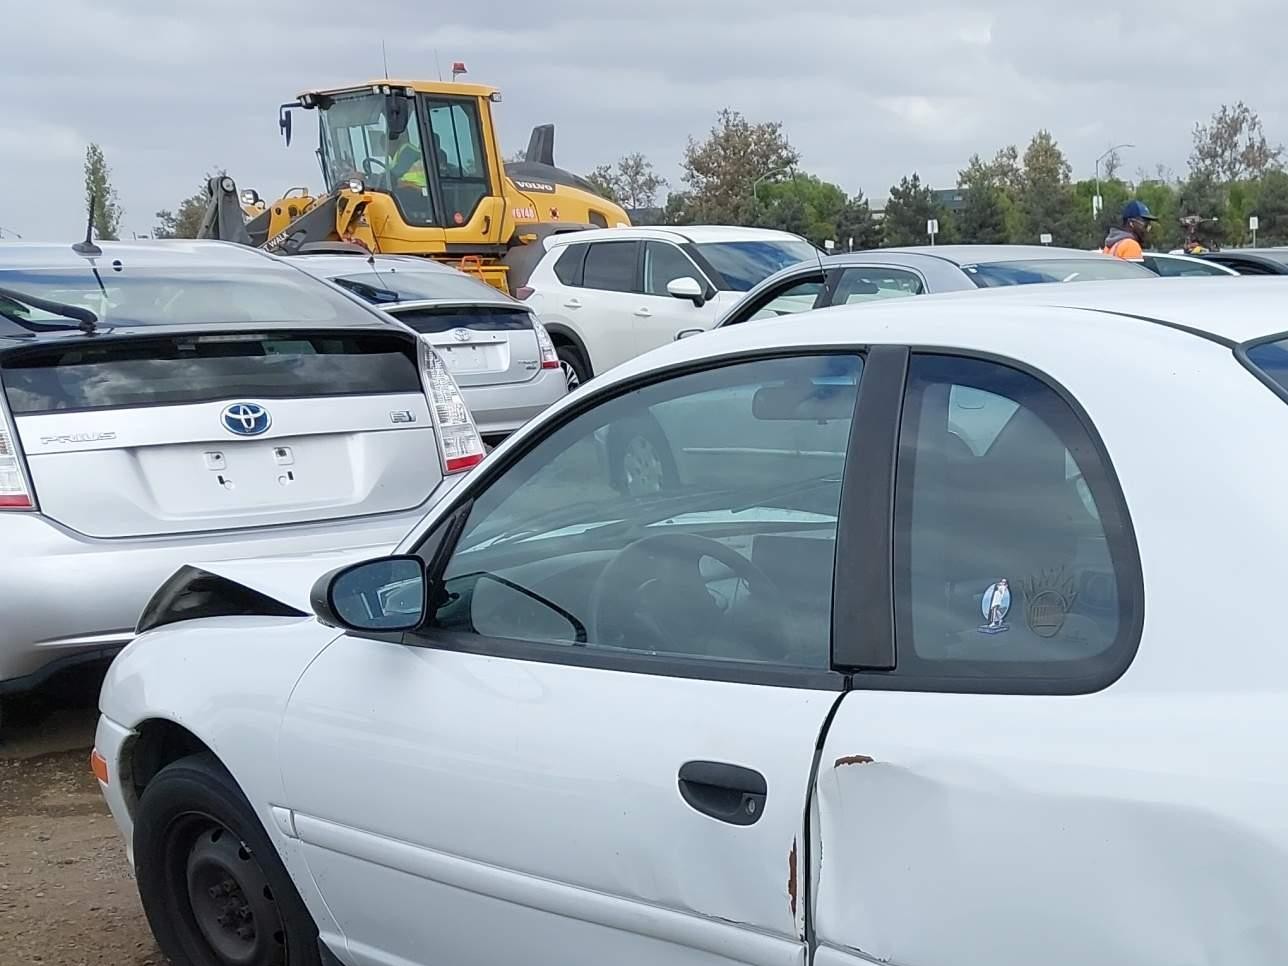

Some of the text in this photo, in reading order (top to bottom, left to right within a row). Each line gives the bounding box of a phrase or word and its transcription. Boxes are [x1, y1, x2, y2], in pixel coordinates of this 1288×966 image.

[515, 181, 553, 191] VOLVO
[268, 231, 290, 248] WALK
[39, 432, 117, 445] PRIUS
